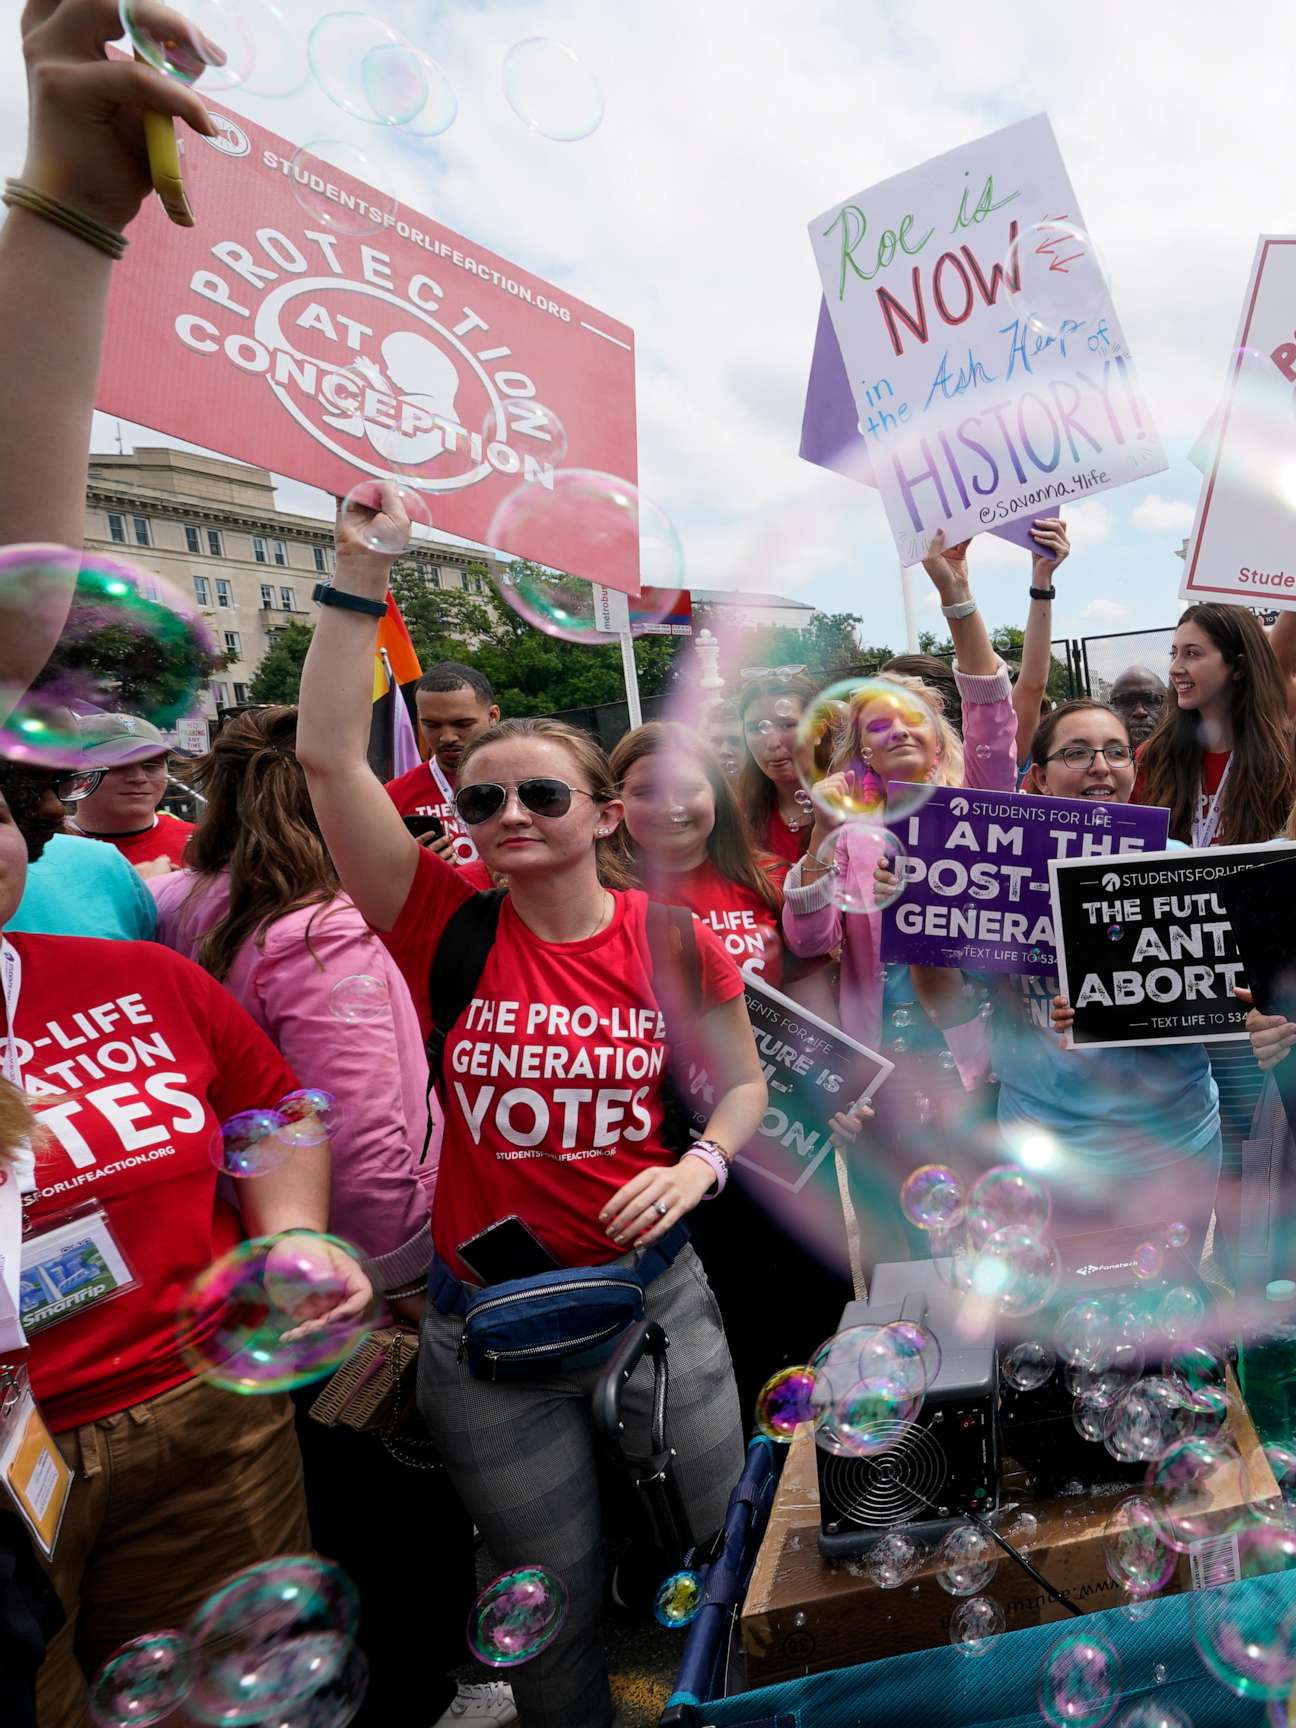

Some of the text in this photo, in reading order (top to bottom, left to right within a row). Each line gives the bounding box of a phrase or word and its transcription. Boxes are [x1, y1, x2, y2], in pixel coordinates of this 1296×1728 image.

[262, 148, 572, 323] STUDENTSFORLIFEACTION.ORG
[822, 170, 1021, 301] Roe is
[874, 219, 1022, 357] NOW
[189, 226, 553, 443] PROTECTION
[295, 302, 374, 352] AT
[861, 377, 894, 407] in
[866, 312, 1111, 443] the Ash Heap of
[174, 312, 556, 492] CONCEPTION
[891, 354, 1148, 533] HISTORY!
[908, 816, 920, 846] I
[944, 820, 1025, 856] AM
[972, 802, 1113, 829] STUDENTS FOR LIFE
[893, 855, 1050, 902] POST-
[1122, 869, 1195, 887] STUDENTS
[1194, 866, 1225, 881] FOR
[1082, 897, 1142, 926] THE
[962, 943, 991, 960] TEXT
[993, 949, 1018, 962] LIFE
[1131, 920, 1241, 963] ANT
[464, 997, 667, 1040] THE PRO-LIFE
[779, 1017, 806, 1040] FOR
[1151, 1016, 1179, 1029] TEXT
[1181, 1014, 1206, 1027] LIFE
[1208, 1013, 1225, 1025] TO
[451, 1038, 665, 1080] GENERATION
[815, 1067, 845, 1094] IS
[453, 1080, 652, 1149] VOTES
